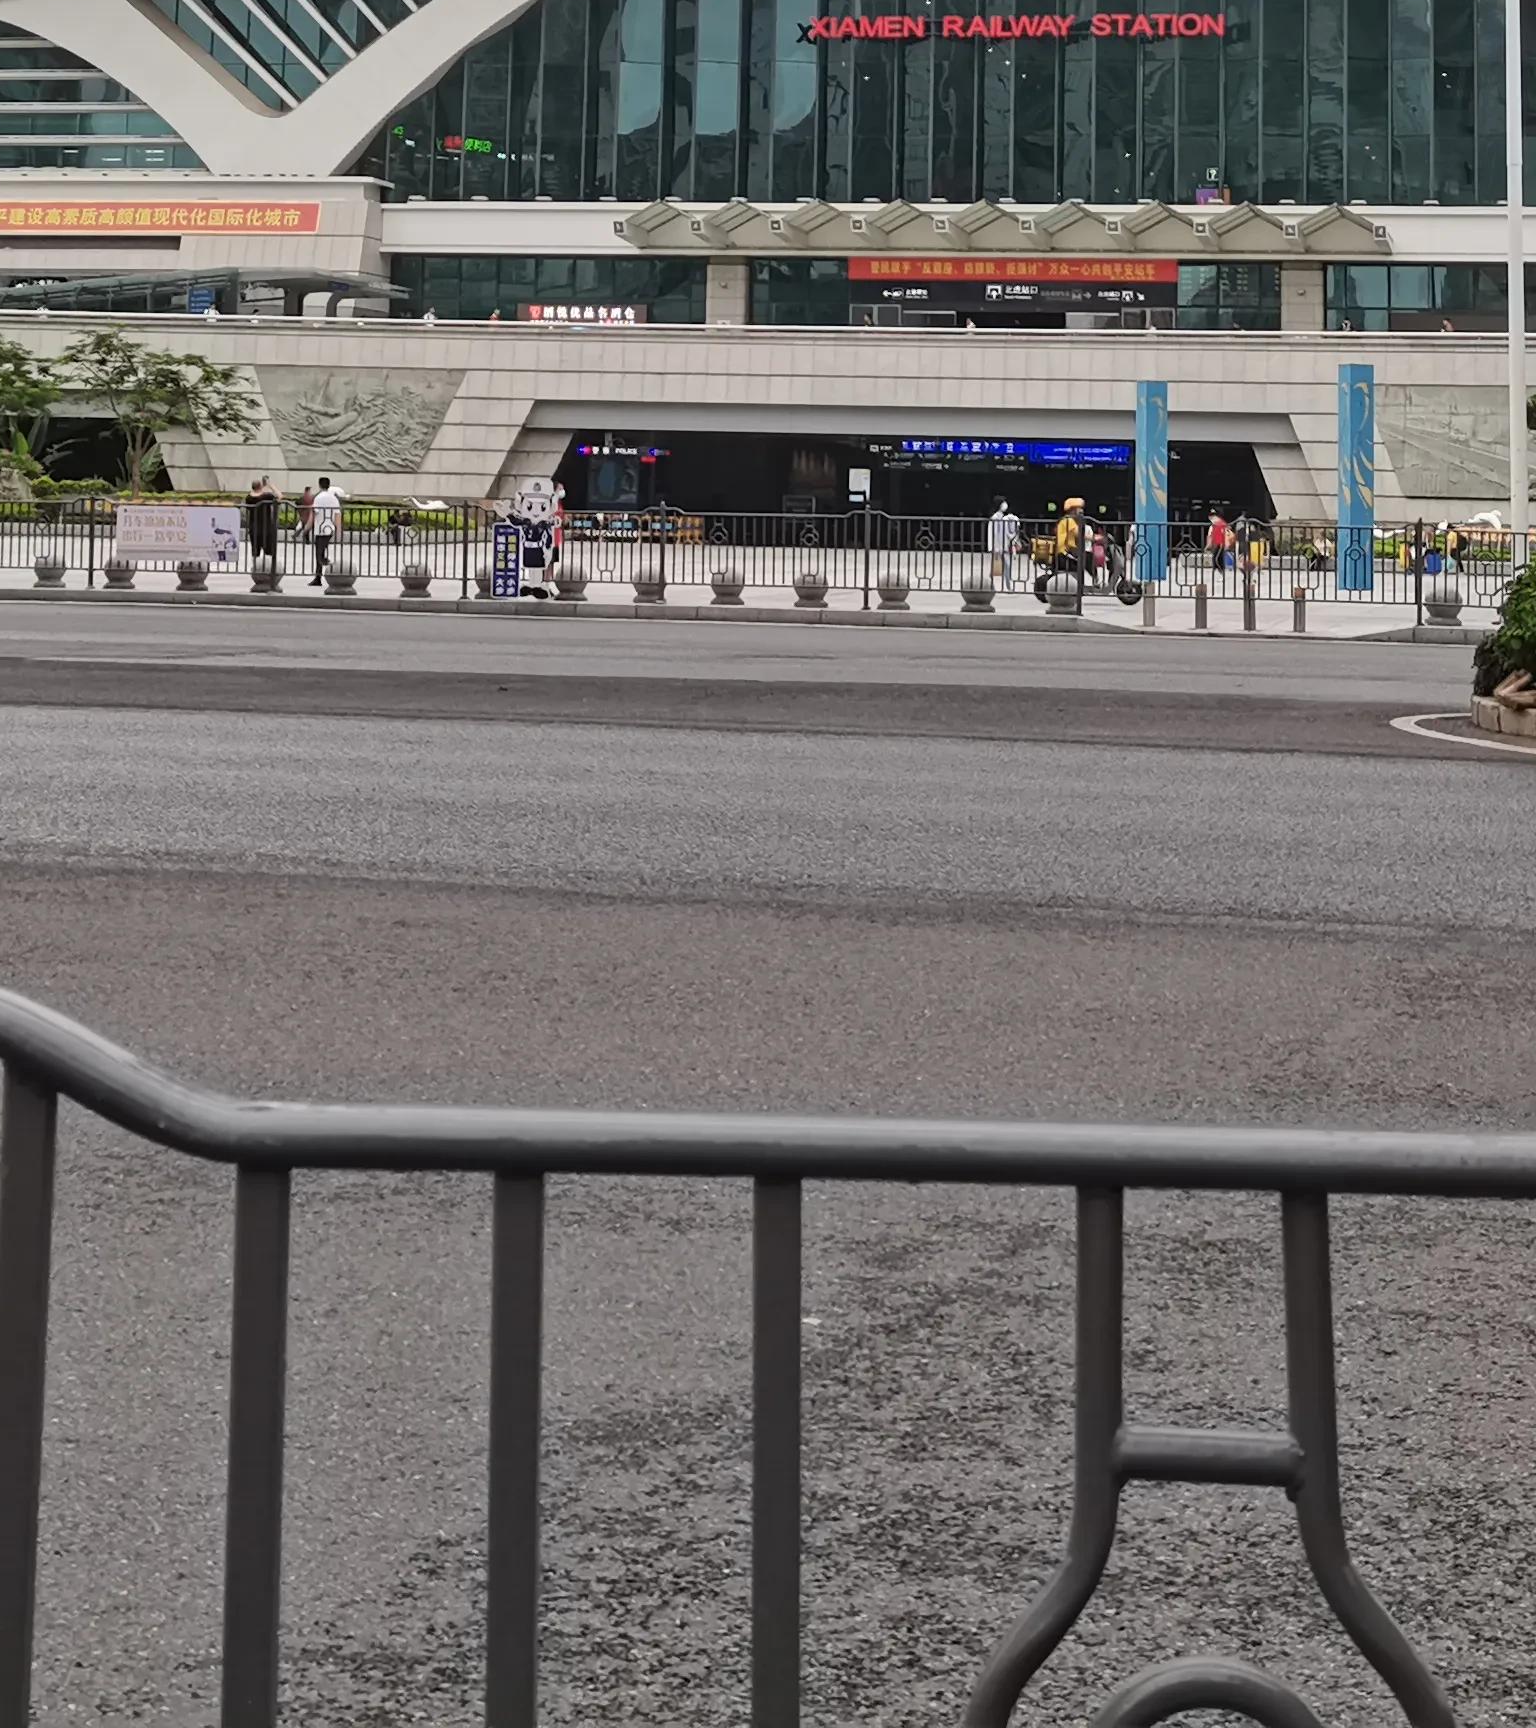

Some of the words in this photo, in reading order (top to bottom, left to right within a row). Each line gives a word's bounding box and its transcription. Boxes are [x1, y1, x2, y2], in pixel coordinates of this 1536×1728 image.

[810, 15, 925, 39] XIAMEN
[943, 14, 1076, 38] RAILWAY
[1091, 13, 1225, 37] STATION
